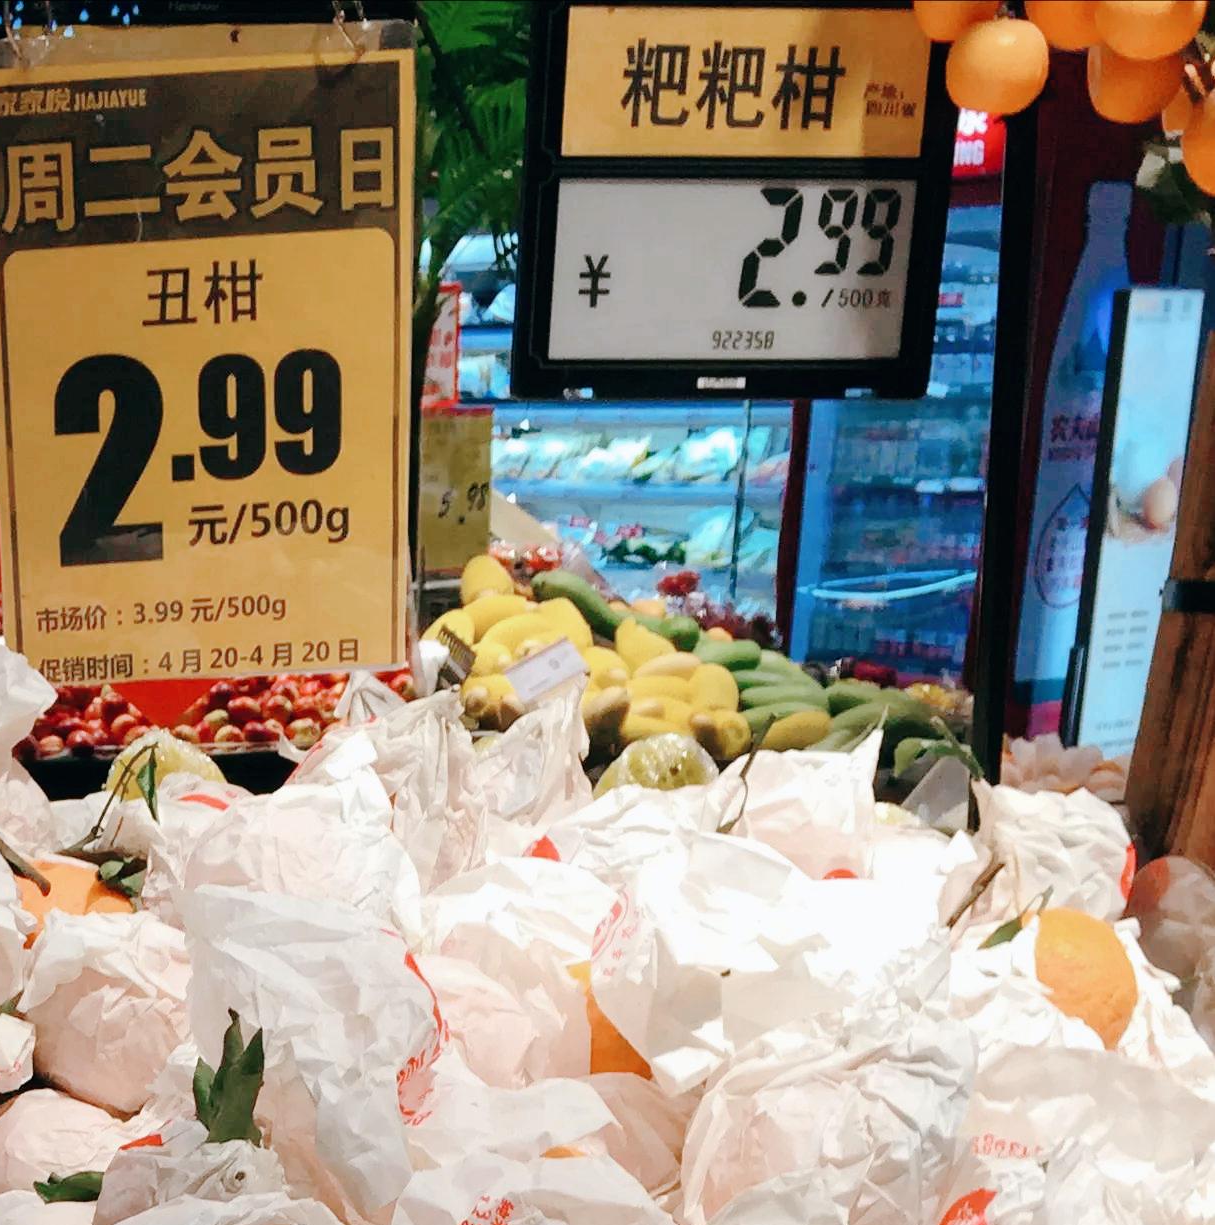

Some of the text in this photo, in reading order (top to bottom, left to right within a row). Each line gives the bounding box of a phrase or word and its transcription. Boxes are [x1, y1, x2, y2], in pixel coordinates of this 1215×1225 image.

[621, 38, 847, 131] 粑粑柑
[2, 126, 396, 235] 周二会员日
[142, 258, 263, 328] 丑柑
[738, 187, 903, 310] 2.99
[53, 348, 343, 568] 2.99
[187, 499, 351, 547] 元/500g
